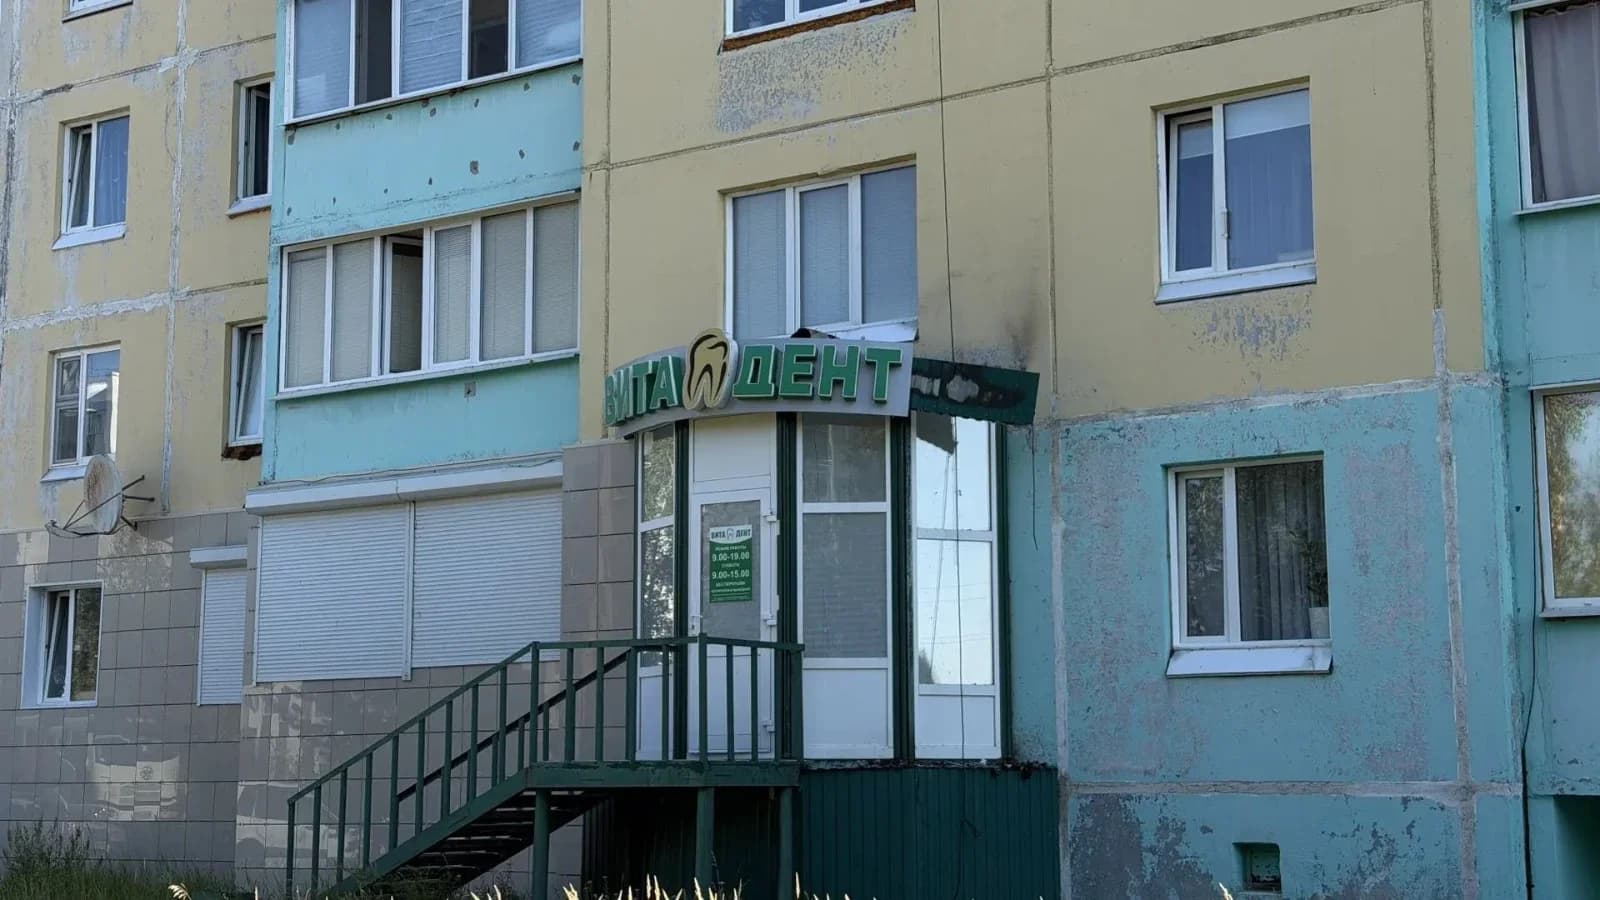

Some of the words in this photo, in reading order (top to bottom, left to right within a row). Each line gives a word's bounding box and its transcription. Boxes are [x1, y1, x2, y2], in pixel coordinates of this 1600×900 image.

[604, 355, 684, 425] ВИТА
[732, 344, 902, 404] ДЕНТ
[711, 552, 750, 562] 9.00-19.00
[711, 569, 750, 579] 9.00-15.00
